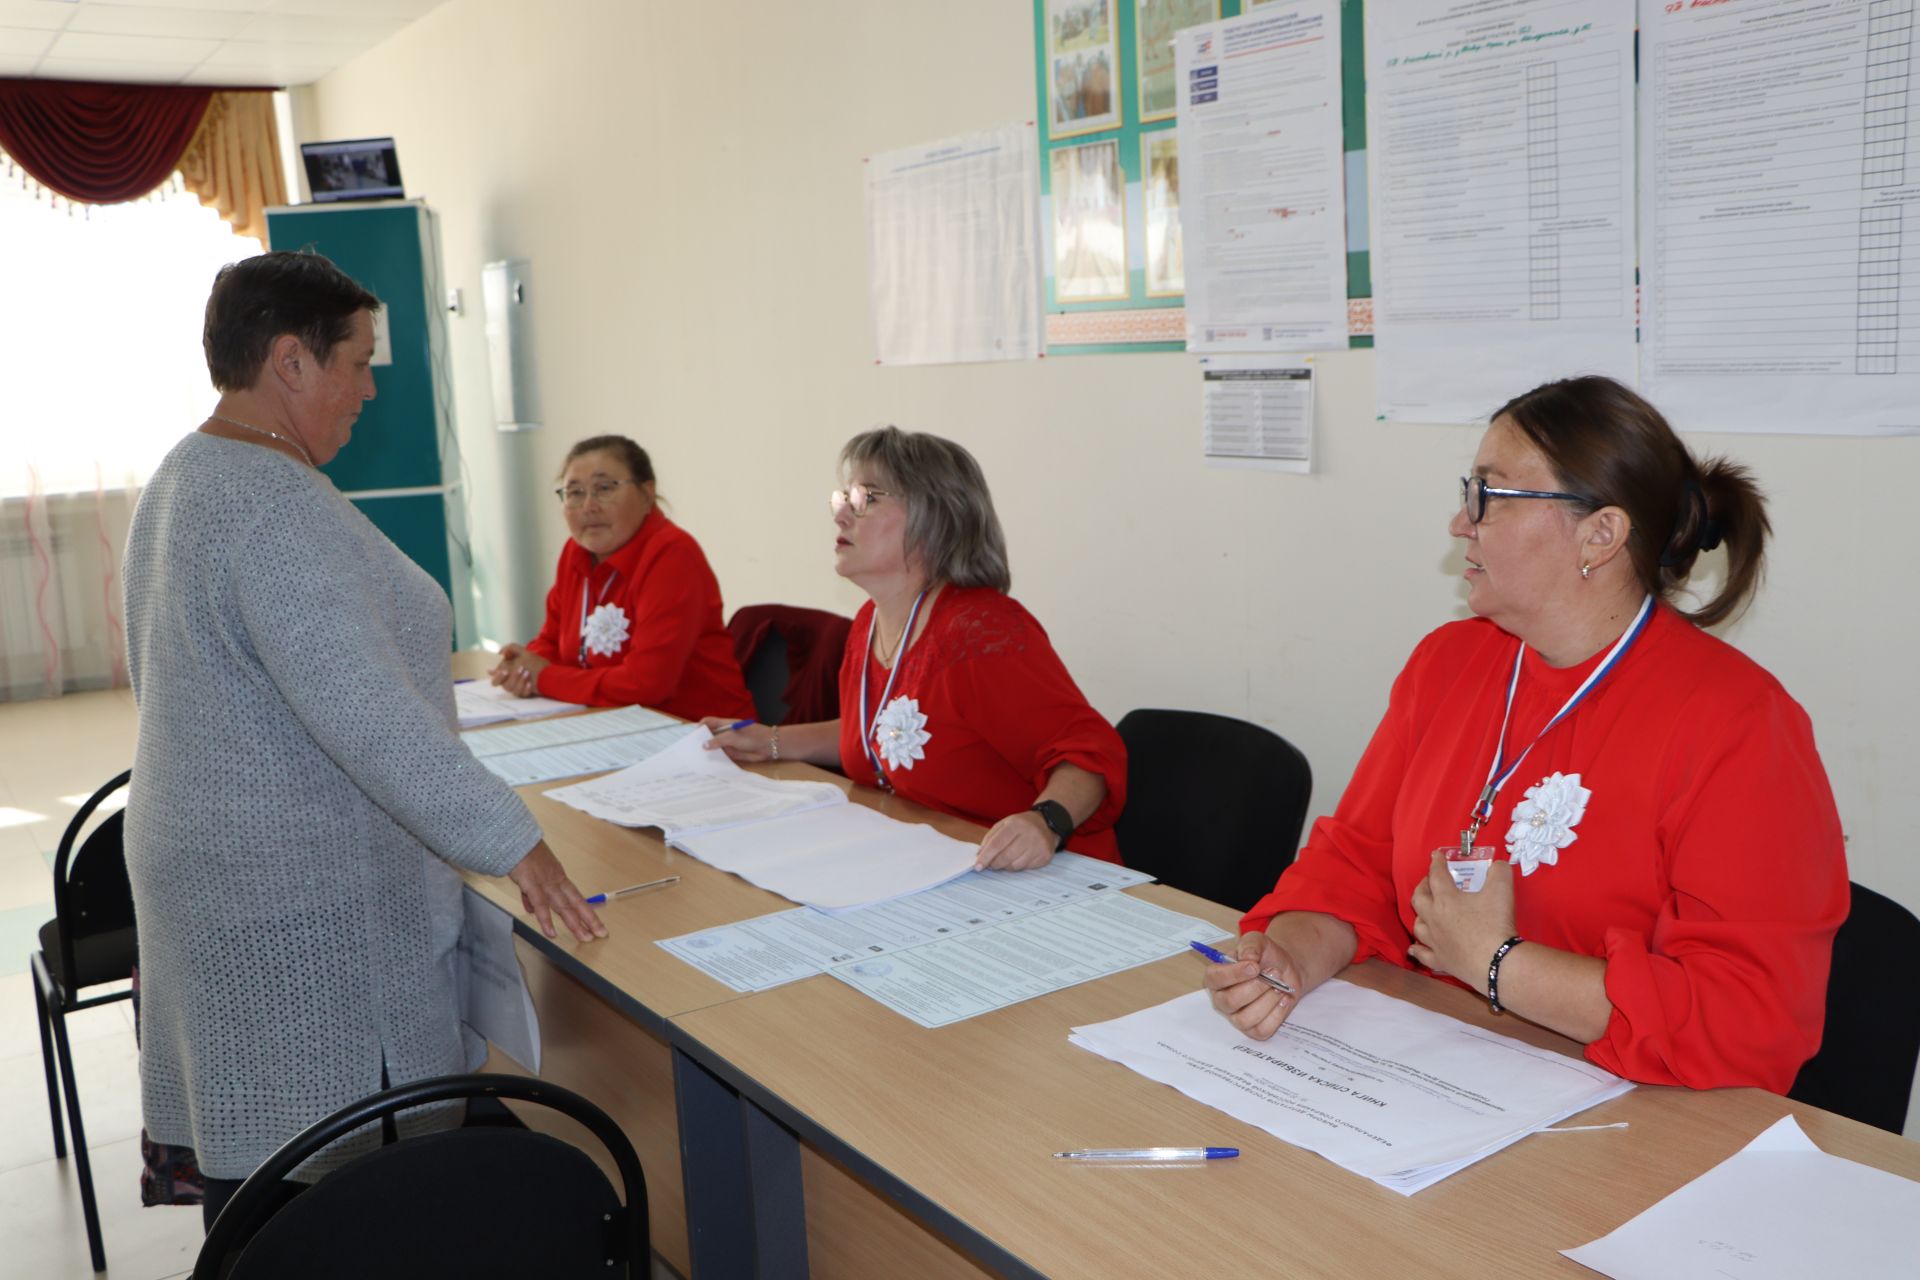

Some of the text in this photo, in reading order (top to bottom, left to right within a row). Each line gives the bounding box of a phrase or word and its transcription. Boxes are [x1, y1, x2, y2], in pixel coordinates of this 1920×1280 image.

[1232, 1045, 1308, 1077] ИЗБИРАТЕЛЕЙ
[1308, 1075, 1350, 1092] СПИСКА
[1351, 1091, 1387, 1107] КНИГА
